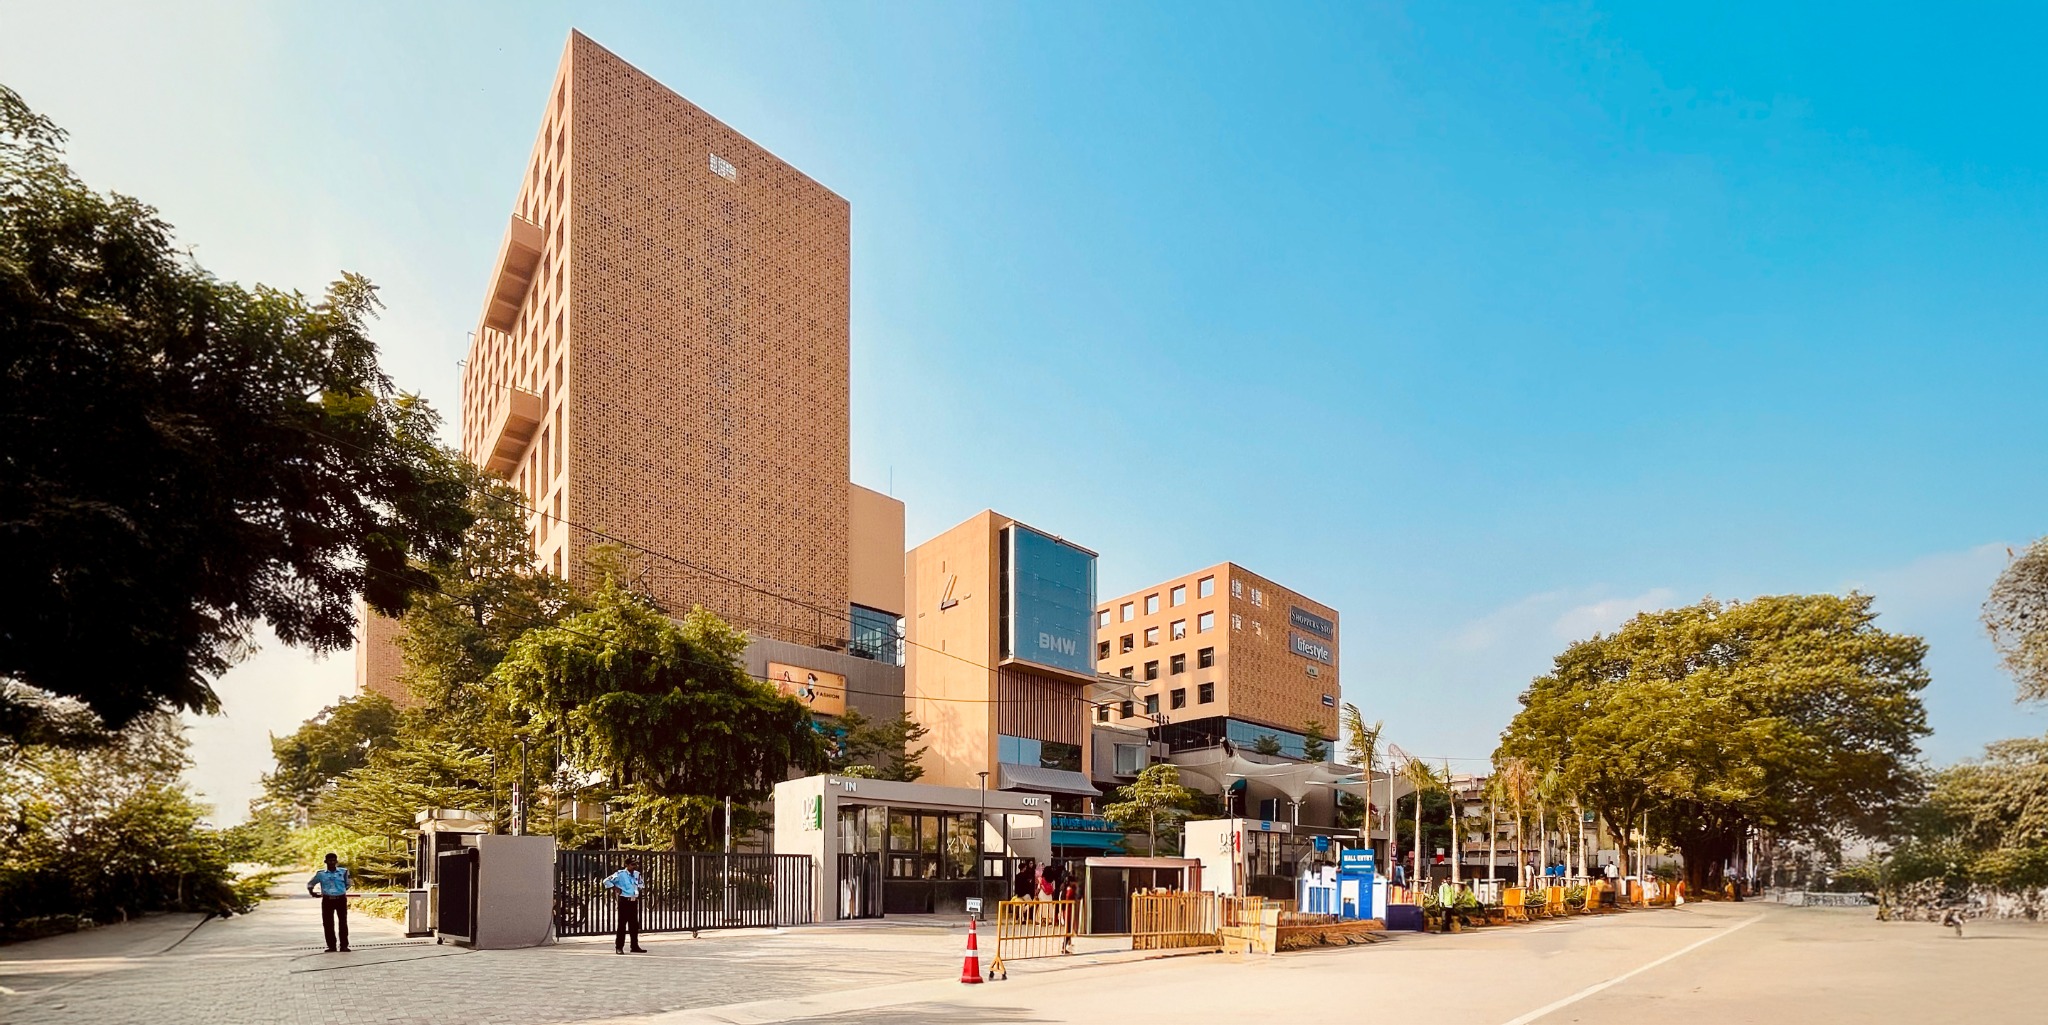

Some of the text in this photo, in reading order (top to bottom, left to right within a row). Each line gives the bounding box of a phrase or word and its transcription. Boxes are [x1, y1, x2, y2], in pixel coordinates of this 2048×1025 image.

[1291, 610, 1318, 629] SHOPPERS
[1039, 631, 1076, 656] BMW
[1297, 637, 1328, 660] lifestyle
[816, 691, 840, 700] FASHION
[845, 781, 857, 792] IN
[801, 796, 817, 820] 02
[1022, 797, 1040, 806] OUT
